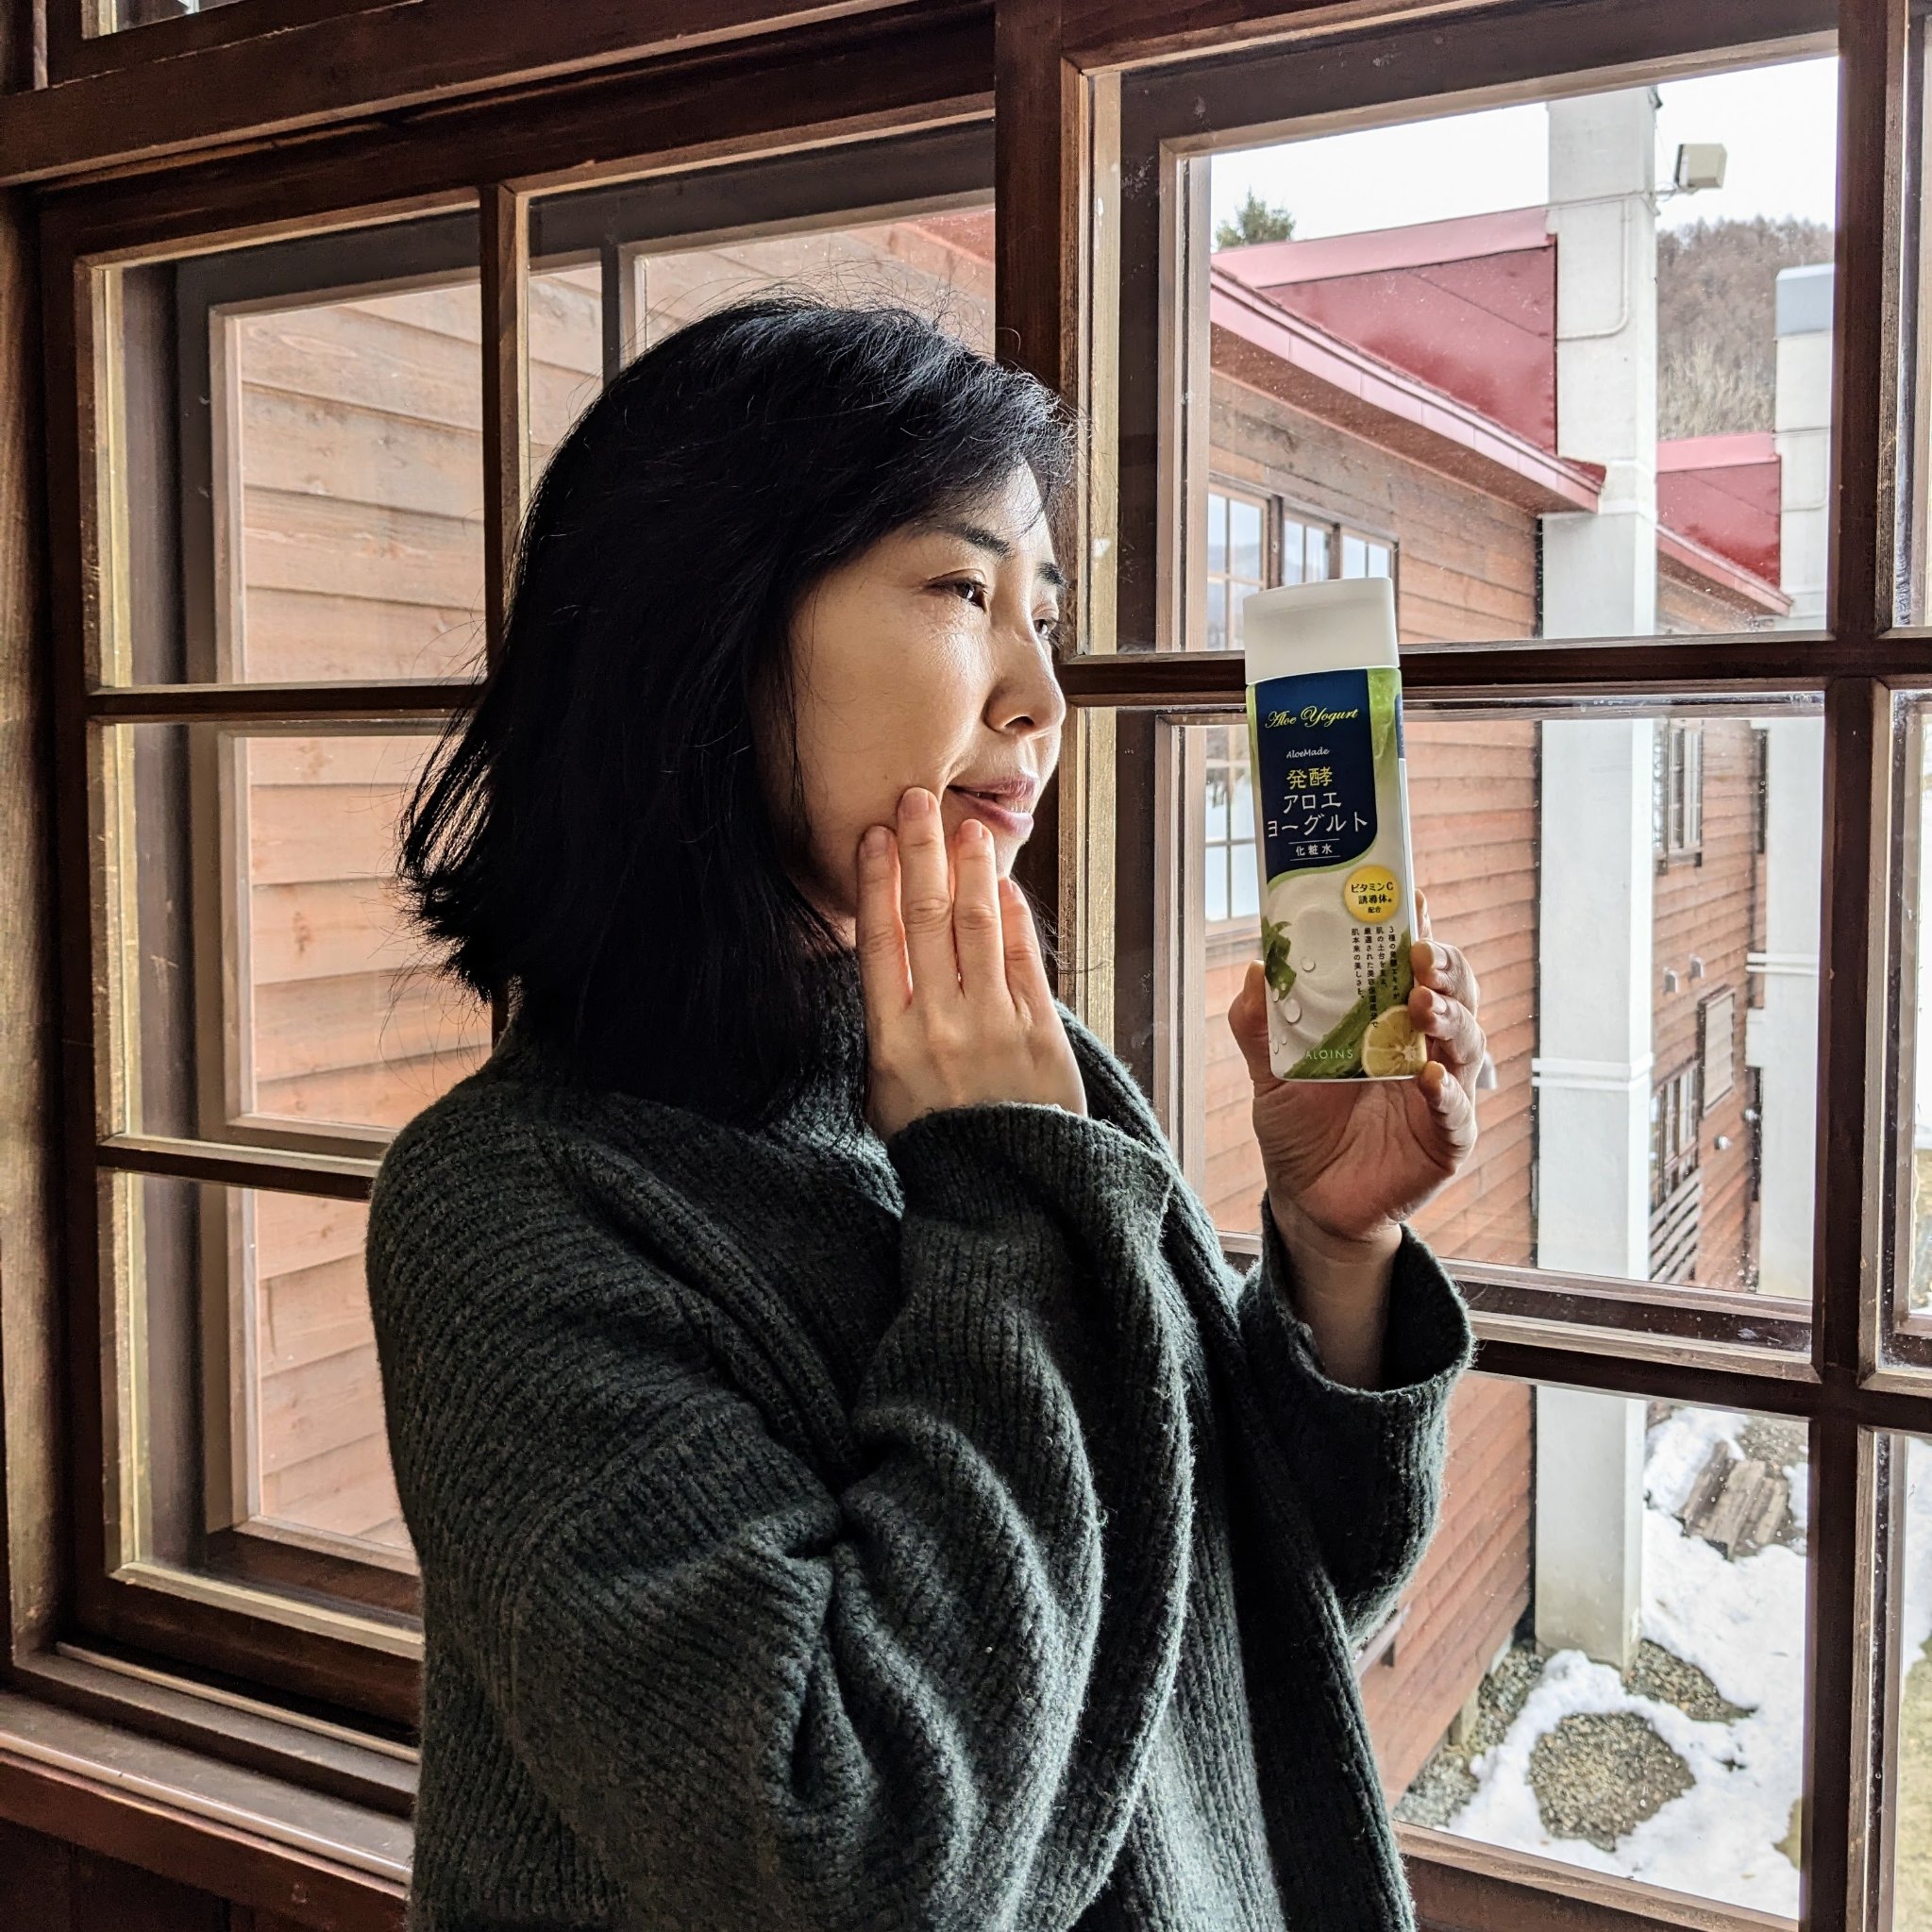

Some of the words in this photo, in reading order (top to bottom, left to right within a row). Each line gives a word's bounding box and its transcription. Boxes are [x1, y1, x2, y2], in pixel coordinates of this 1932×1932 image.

[1265, 711, 1297, 728] Aloe
[1301, 706, 1358, 728] Yogurt
[1286, 766, 1333, 790] 発酵
[1284, 792, 1341, 814] アロエ
[1268, 812, 1368, 837] ヨーグルト
[1296, 843, 1333, 856] 化粧水
[1351, 882, 1393, 893] ビタミンC
[1305, 1049, 1353, 1059] ALOINS
